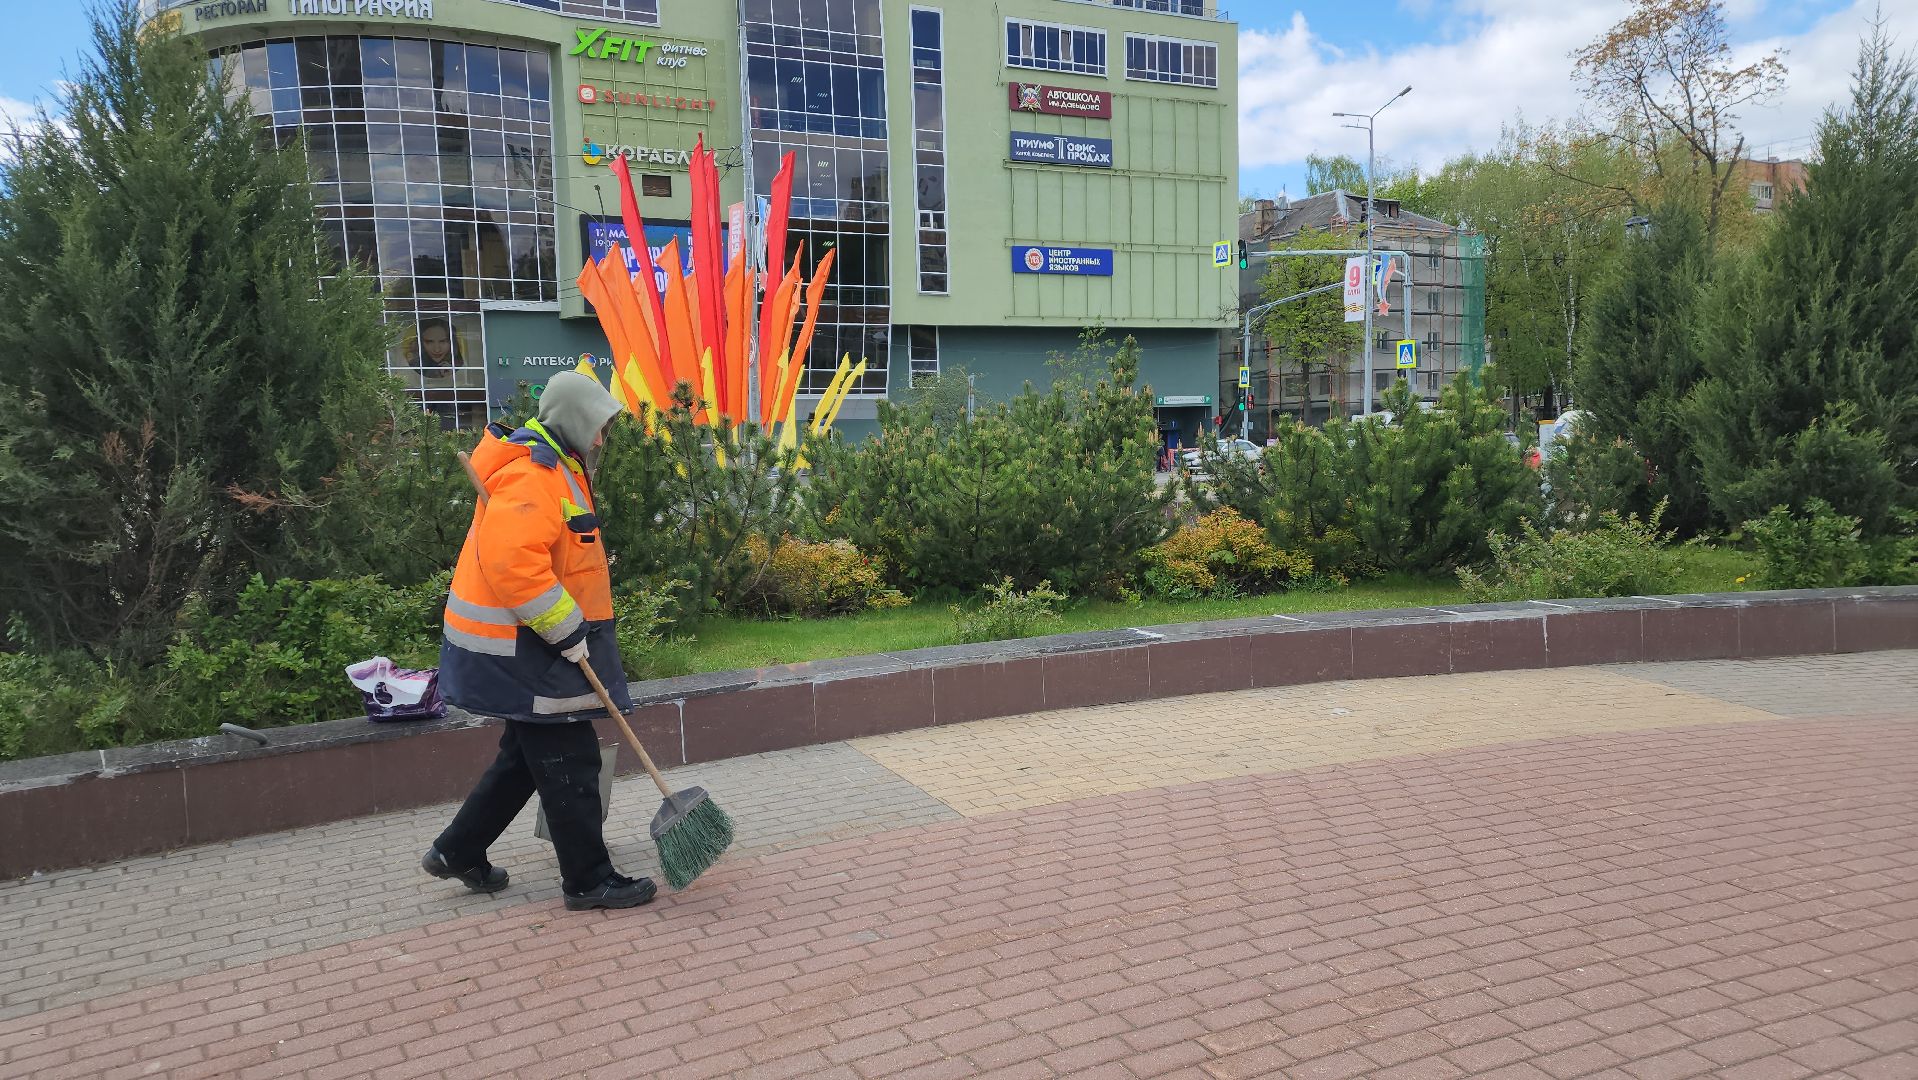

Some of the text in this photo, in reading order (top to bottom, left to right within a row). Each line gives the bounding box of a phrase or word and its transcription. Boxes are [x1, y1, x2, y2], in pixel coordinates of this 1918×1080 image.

[195, 0, 268, 21] РЕСТОРАН
[291, 0, 434, 19] ТИПОГРАФИЯ
[661, 41, 708, 57] фитнес
[656, 56, 688, 69] клуб
[604, 89, 716, 113] SUNLIGHT
[1047, 90, 1101, 104] АВТОШКОЛА
[1015, 138, 1055, 150] ТРИУМФ
[1067, 143, 1096, 153] ОФИС
[1067, 151, 1110, 163] ПРОДАЖ
[608, 229, 630, 239] МА
[1048, 249, 1071, 257] ЦЕНТР
[1048, 257, 1101, 266] ИНОСТРАННЫХ
[1048, 264, 1079, 272] ЯЗЫКОВ
[1349, 266, 1361, 288] 9
[523, 356, 576, 366] АПТЕКА
